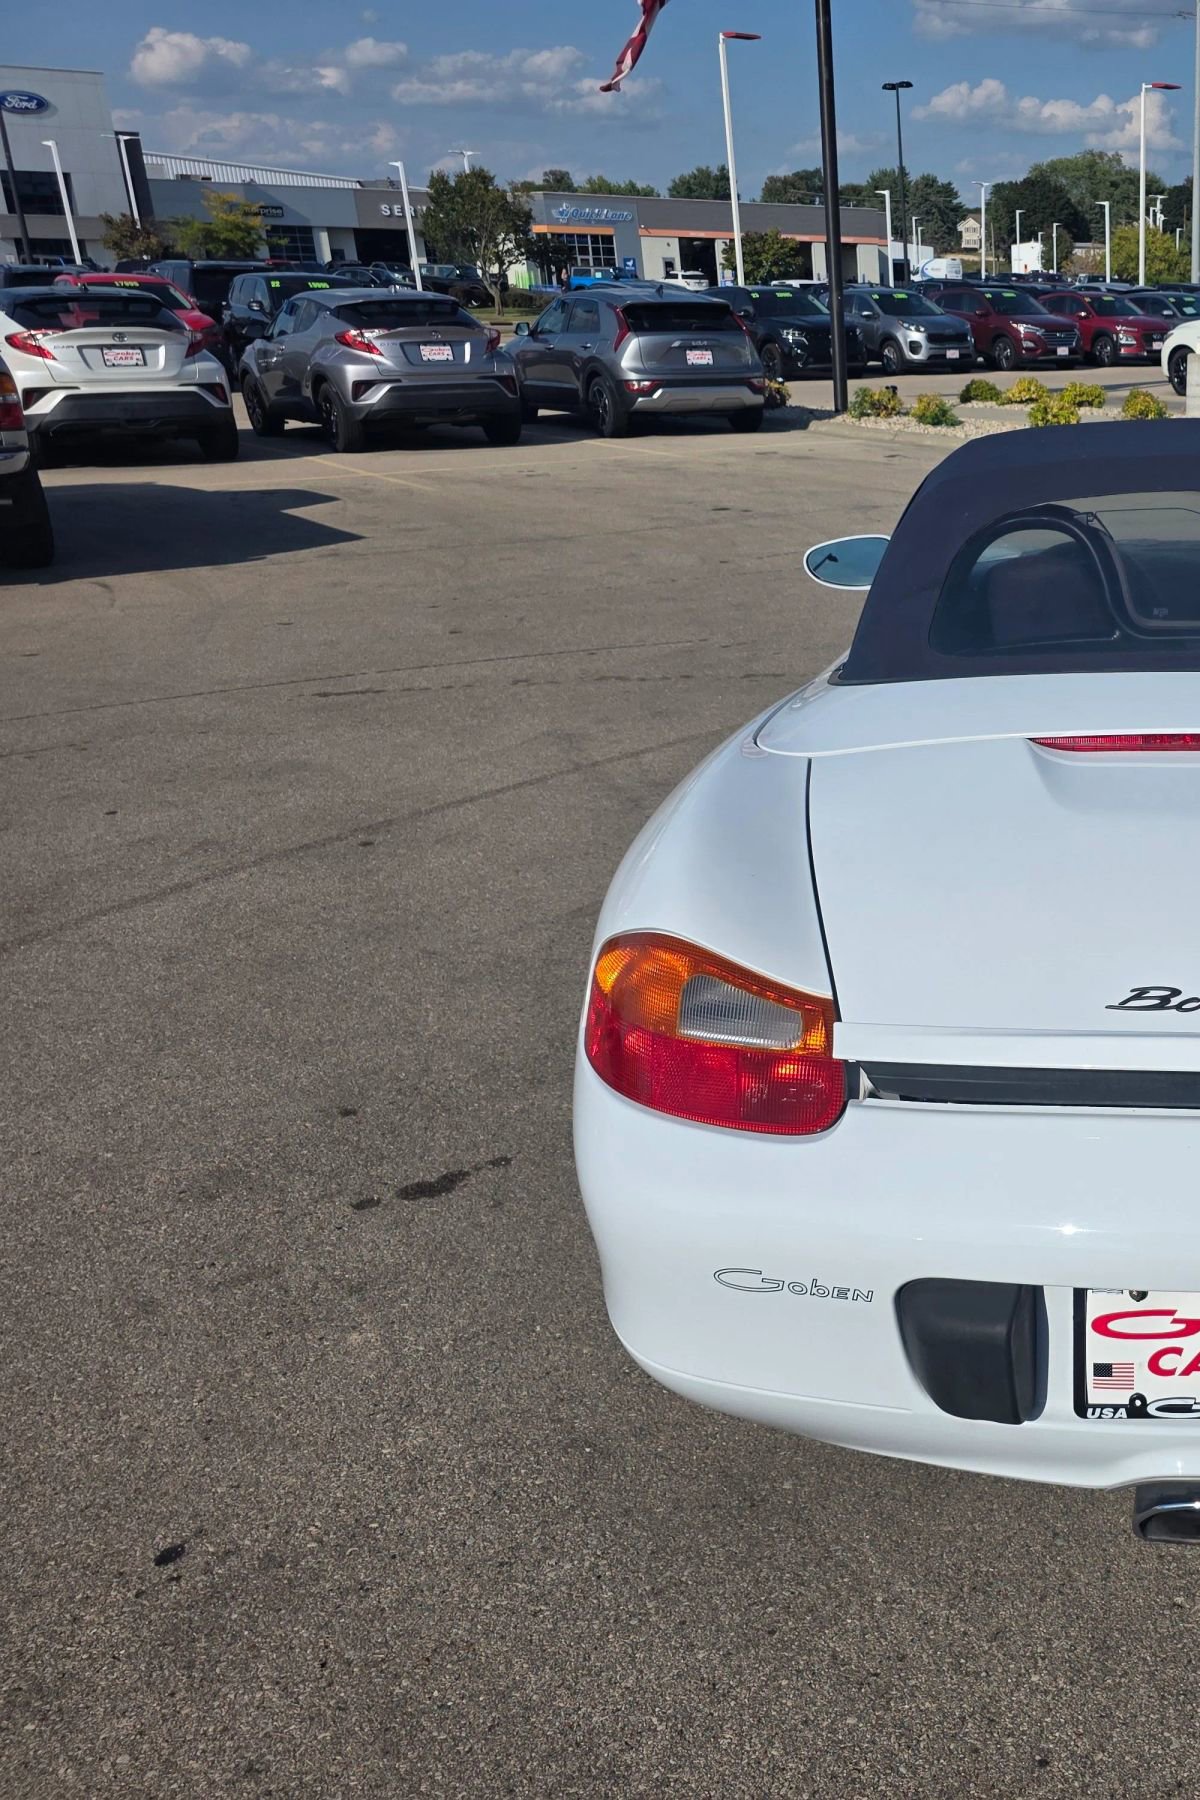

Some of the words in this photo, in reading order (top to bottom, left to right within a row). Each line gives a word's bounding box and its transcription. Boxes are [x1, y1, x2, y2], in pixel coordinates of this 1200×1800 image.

[4, 95, 38, 109] Ford
[571, 207, 602, 220] Quick
[602, 208, 632, 221] Lane
[1086, 1407, 1128, 1419] USA
